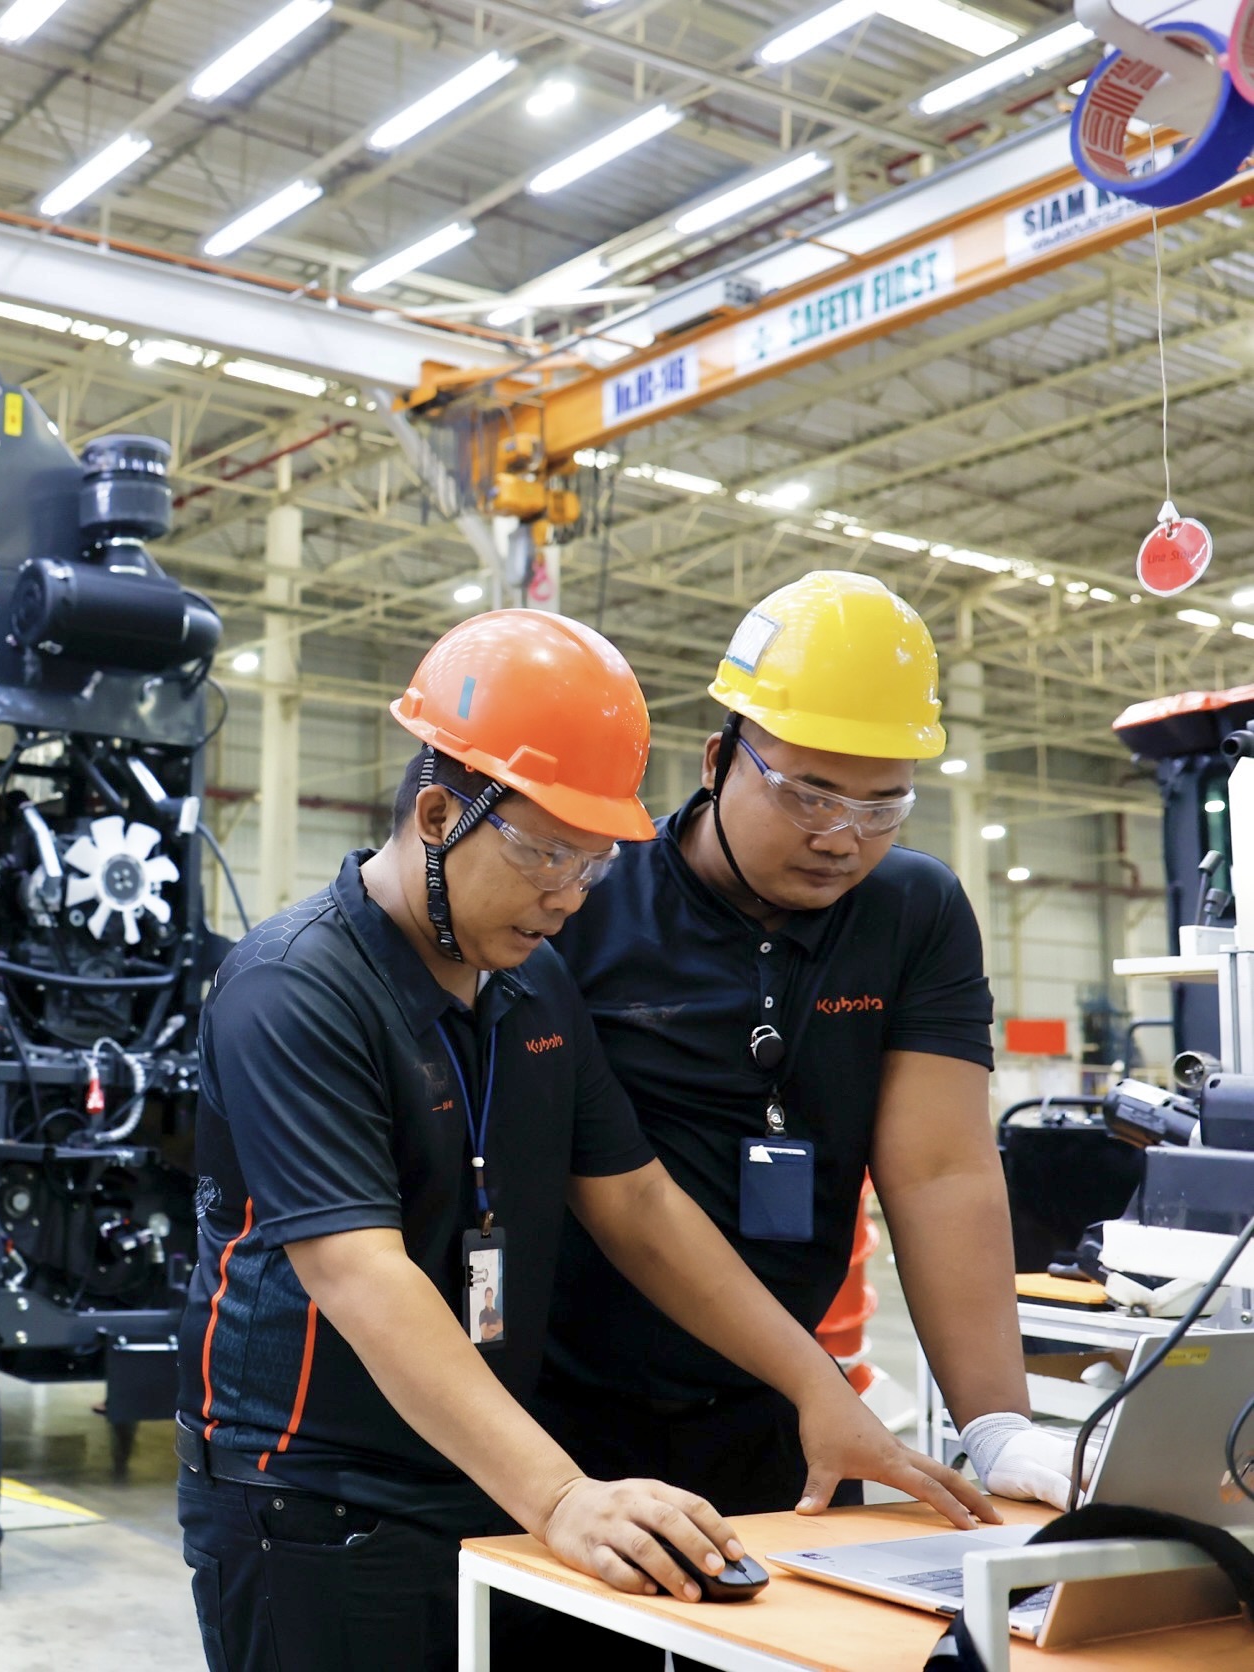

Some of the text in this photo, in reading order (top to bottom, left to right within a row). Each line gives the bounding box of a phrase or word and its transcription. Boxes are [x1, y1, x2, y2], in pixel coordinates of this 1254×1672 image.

[1023, 188, 1086, 236] SIAM
[789, 251, 937, 345] SAFETY FIRST
[816, 994, 883, 1014] Kubota
[525, 1033, 563, 1054] Kubota
